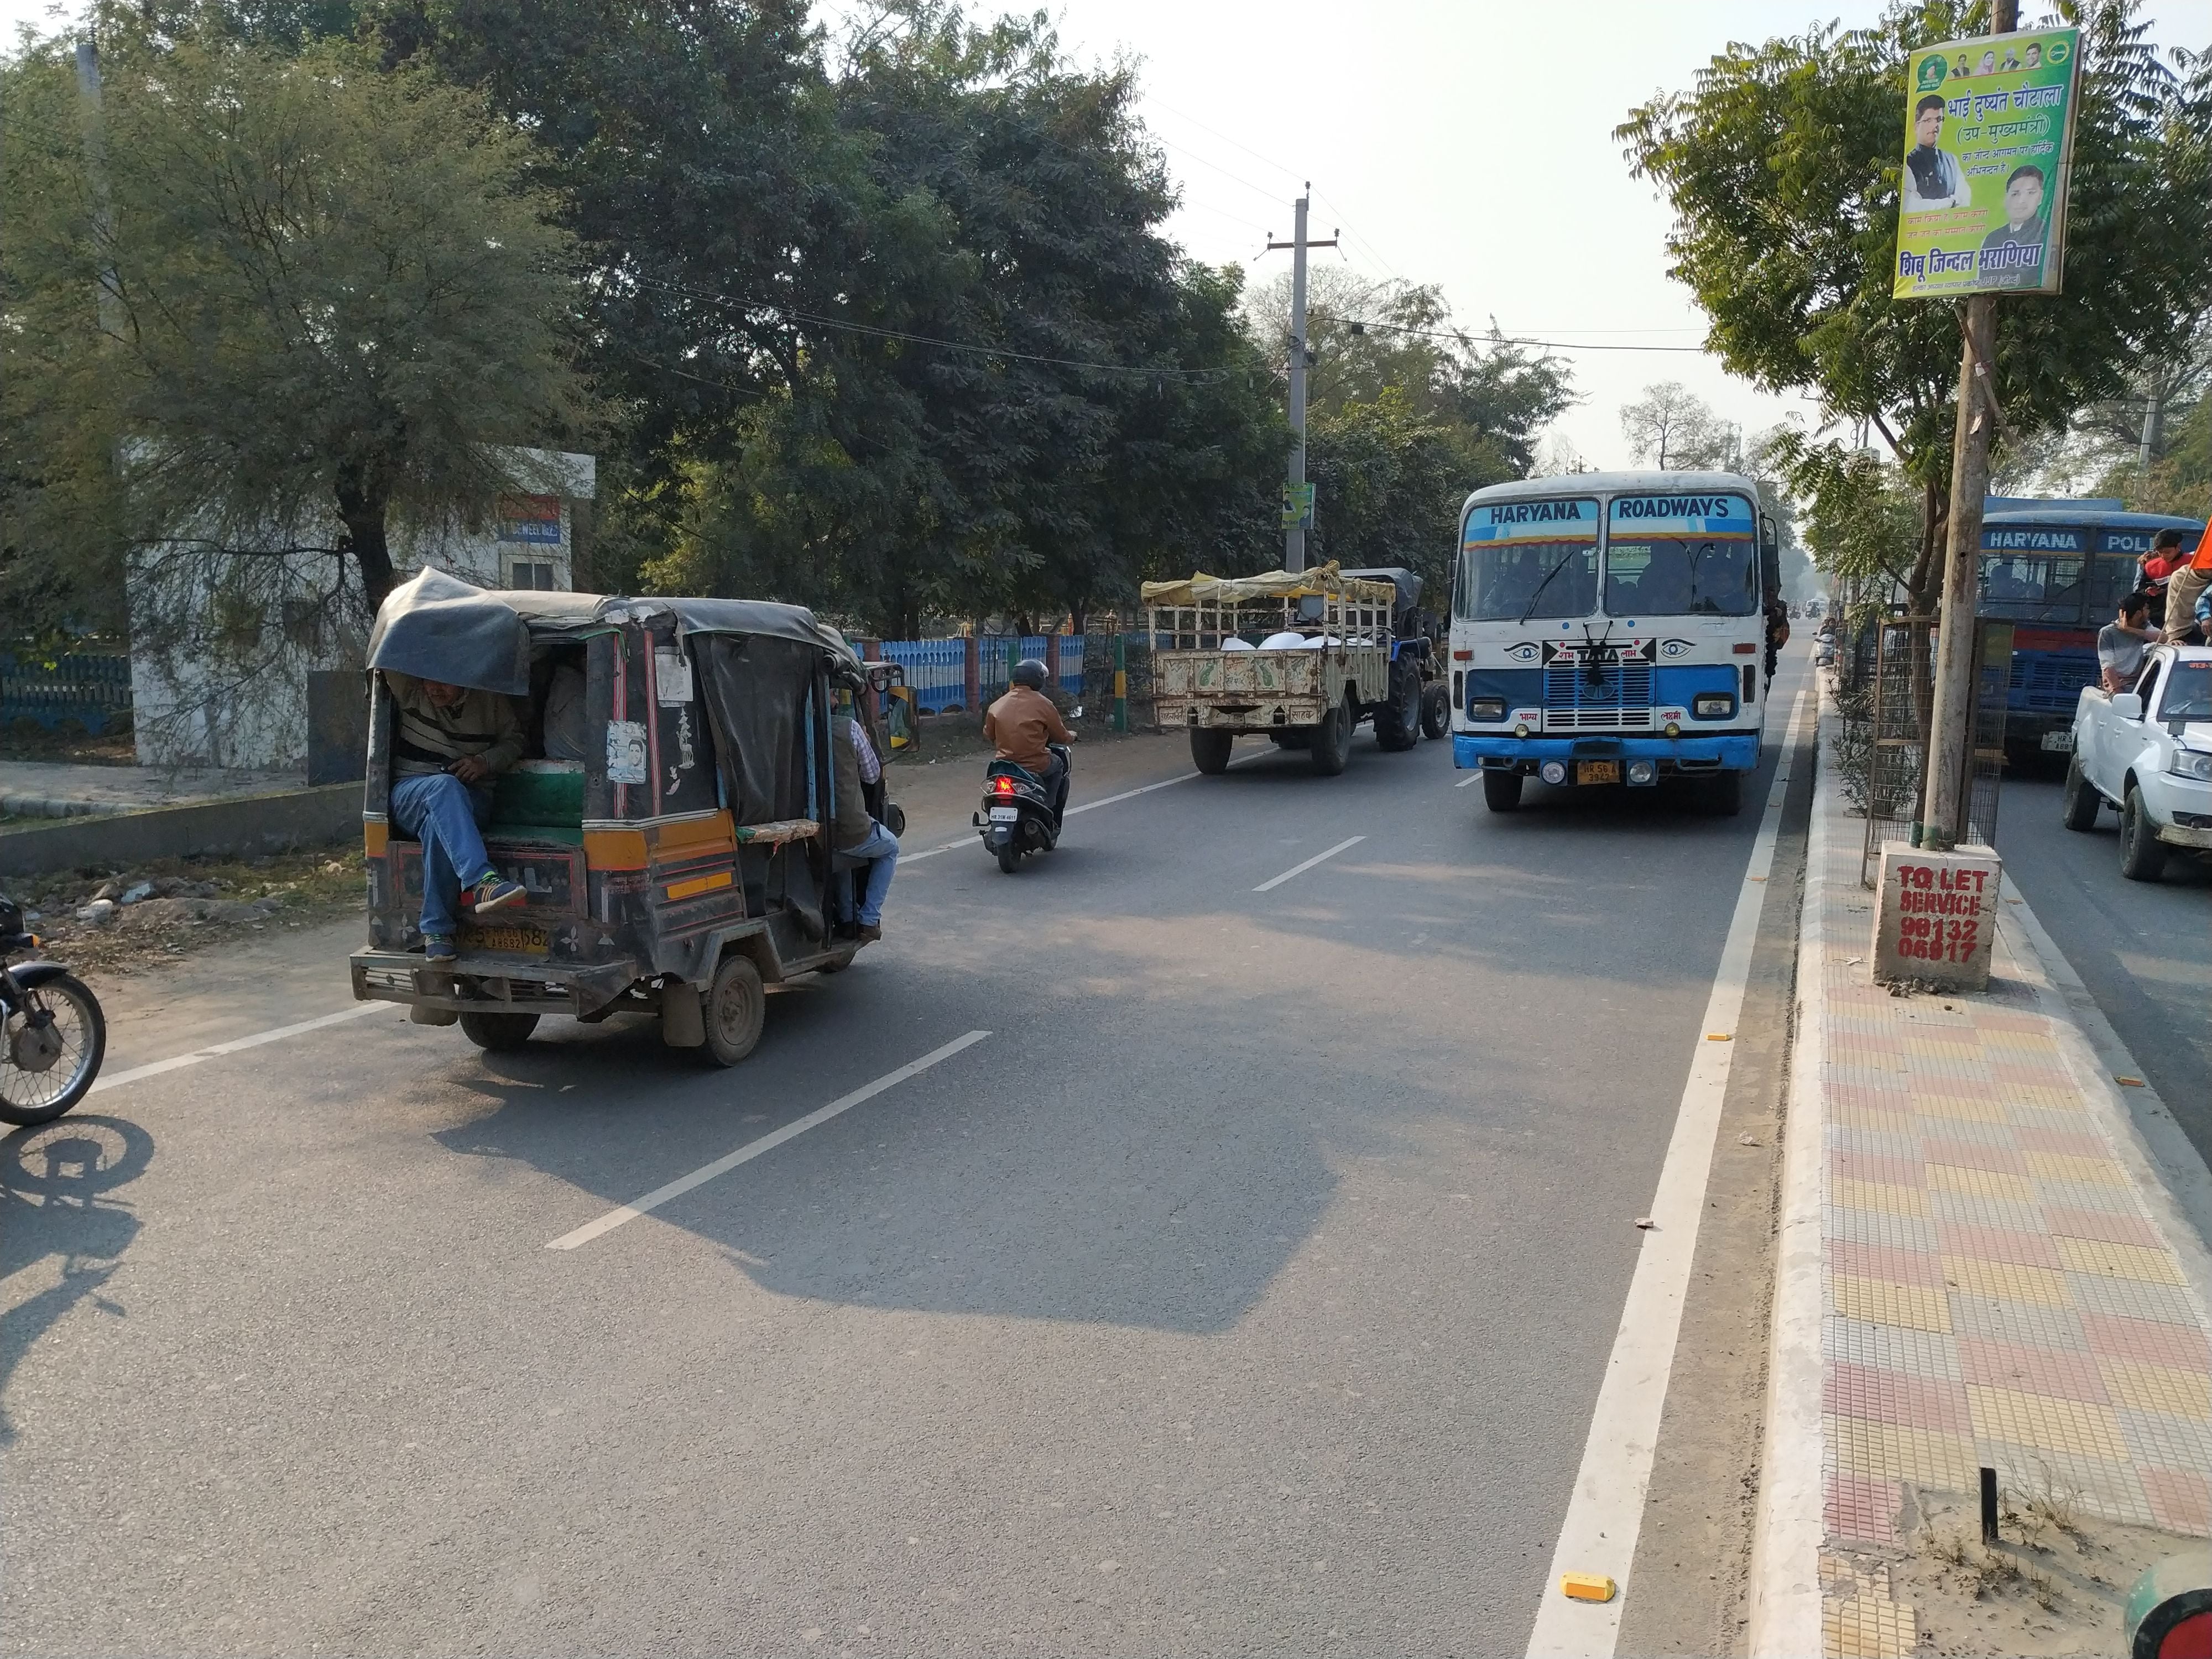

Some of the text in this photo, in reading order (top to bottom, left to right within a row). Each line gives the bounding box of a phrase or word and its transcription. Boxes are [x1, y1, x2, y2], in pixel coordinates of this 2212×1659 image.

[1948, 82, 2063, 121] भाई दुष्यंत चौटाला
[1957, 114, 2050, 145] (उप-मुख्यमंत्री)
[1962, 153, 1971, 162] का
[1992, 148, 2017, 158] आगमन
[2020, 146, 2028, 155] पर
[2031, 140, 2054, 155] हार्दिक
[1967, 165, 1999, 176] अभिनन्दन
[1900, 251, 1926, 283] शिबू
[1928, 248, 1976, 274] जिन्दल
[1981, 275, 1997, 286] JJP
[1491, 498, 1729, 525] HARYANA ROADWAYS
[1990, 531, 2156, 552] HARYANA POLI
[1620, 650, 1637, 659] लाभ
[1519, 713, 1538, 721] भाग्य
[1584, 765, 1616, 774] HR 56 A
[1897, 866, 1989, 893] TO LET
[1900, 890, 1981, 916] SERVICE
